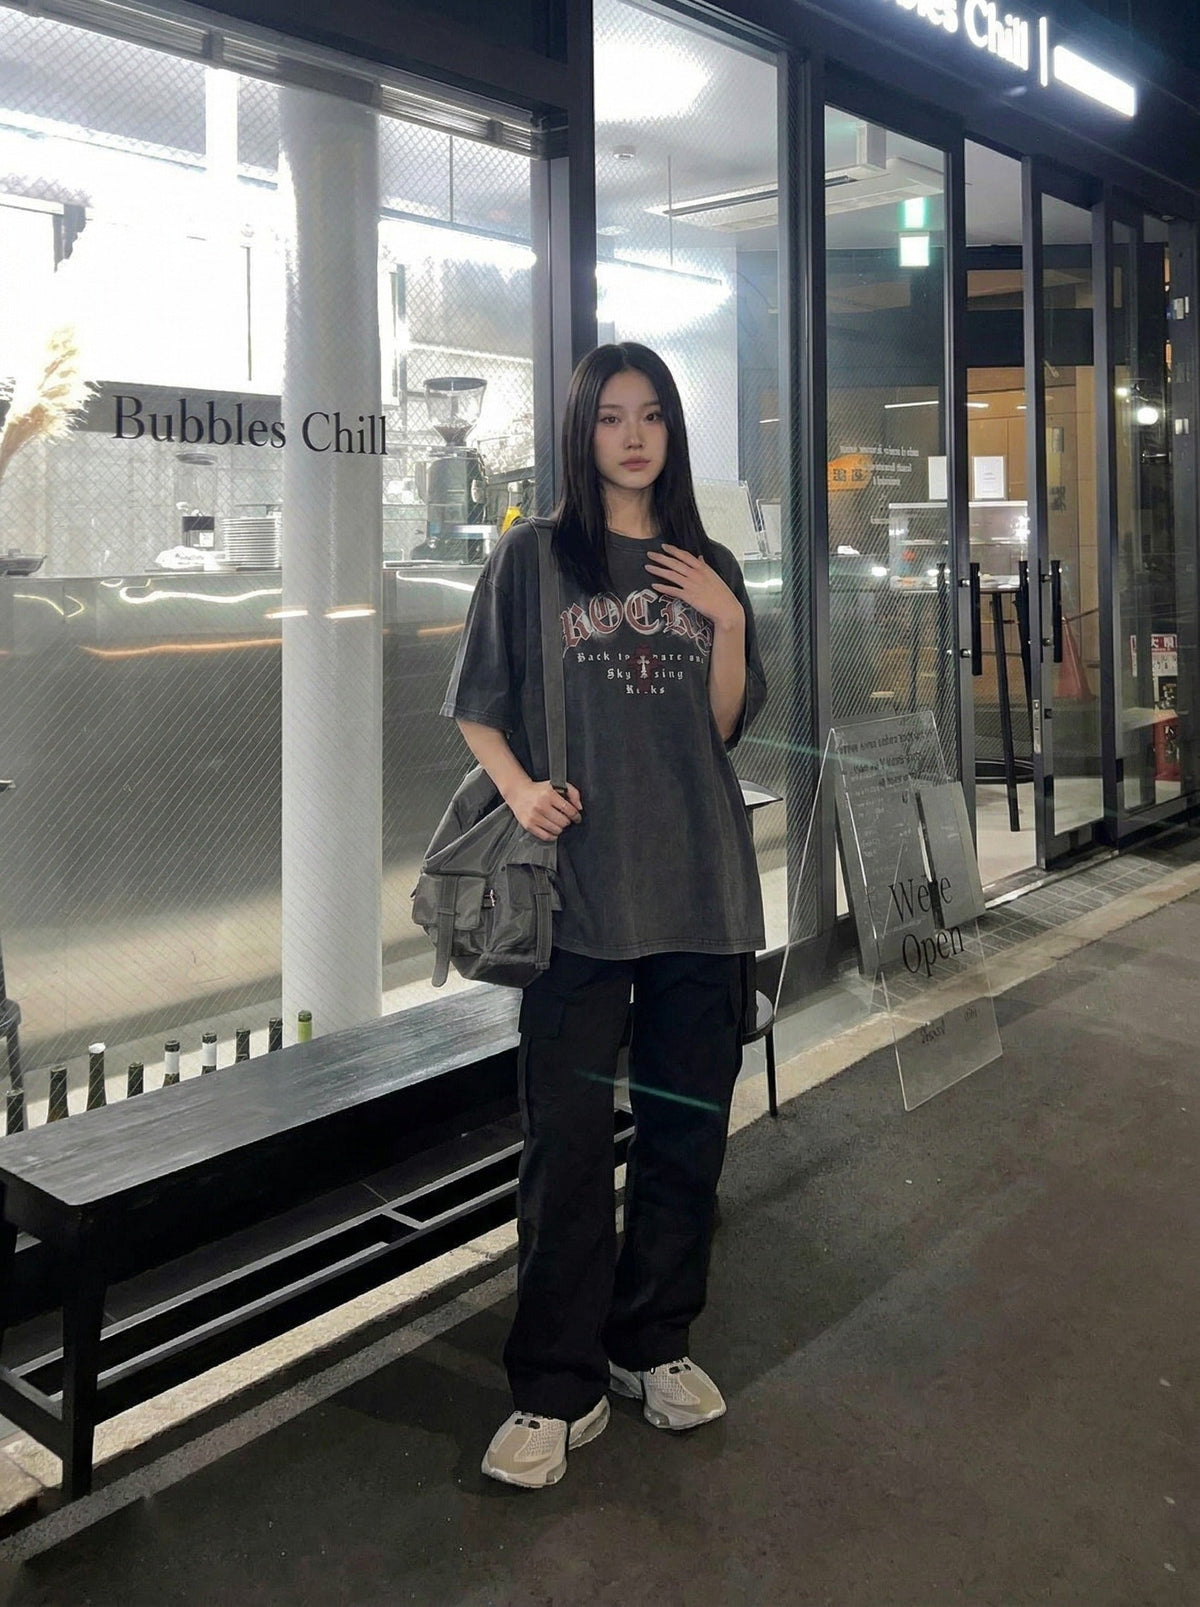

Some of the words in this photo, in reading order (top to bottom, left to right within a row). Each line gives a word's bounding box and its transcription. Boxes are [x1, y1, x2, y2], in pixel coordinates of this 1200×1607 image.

[964, 0, 1029, 71] Chill
[111, 394, 287, 449] Bubbles
[302, 411, 388, 456] Chill
[576, 651, 610, 664] Back
[606, 667, 632, 680] Sky
[888, 875, 953, 923] Wee
[902, 926, 965, 978] Open
